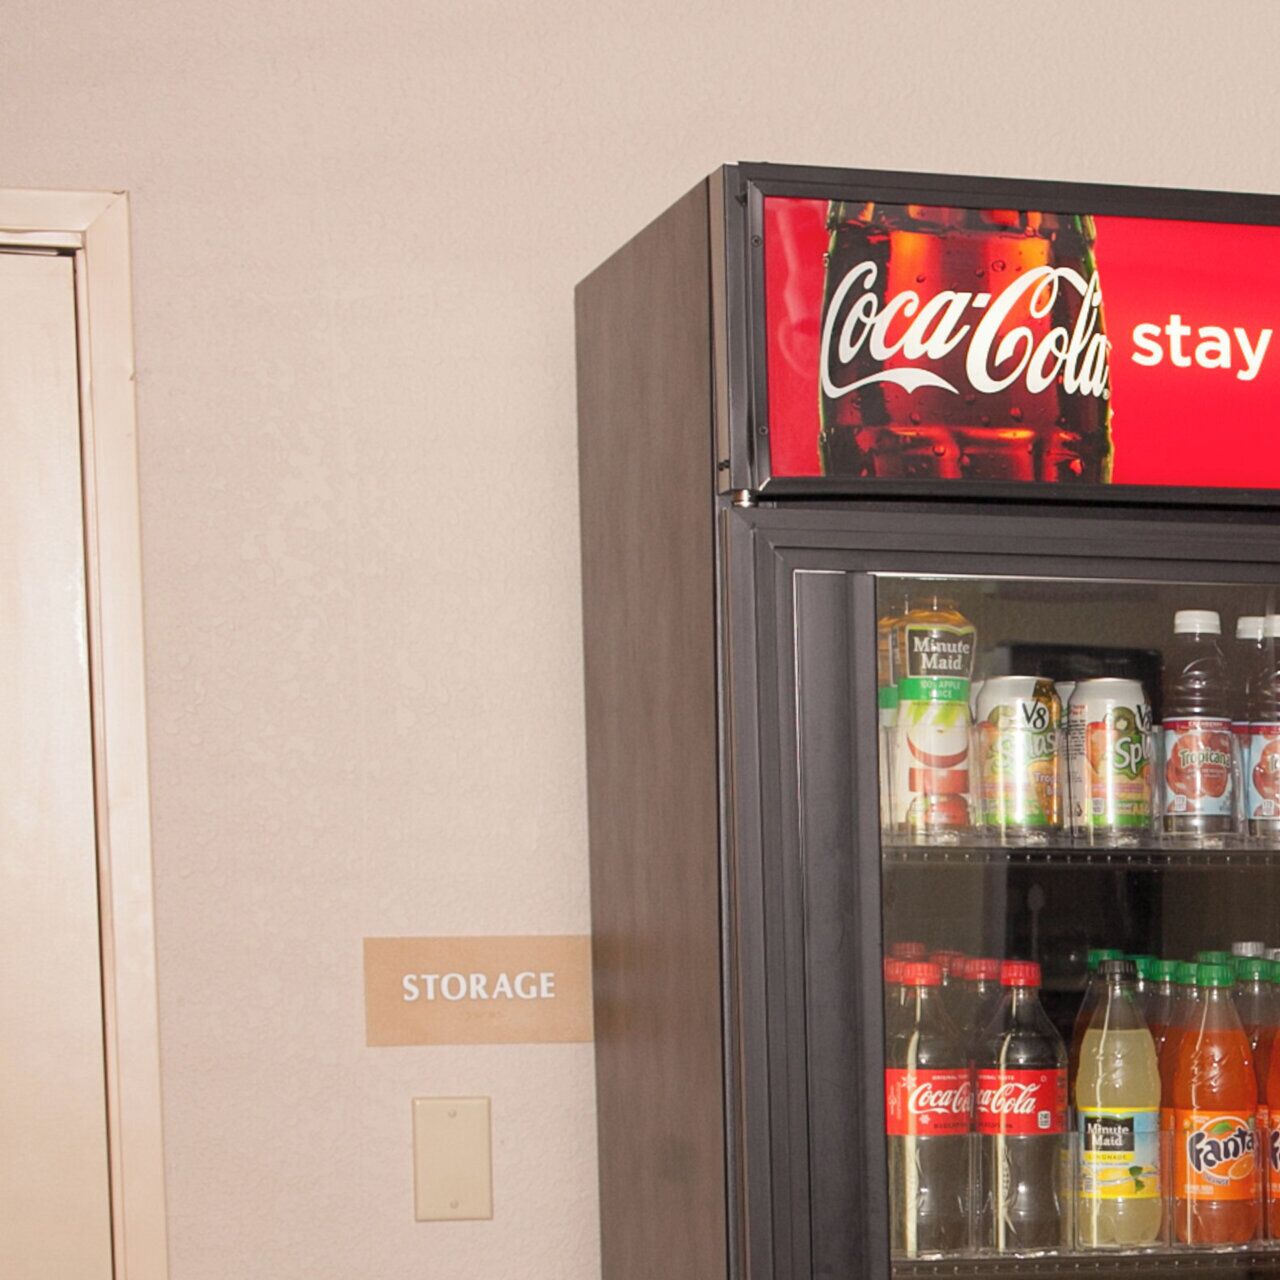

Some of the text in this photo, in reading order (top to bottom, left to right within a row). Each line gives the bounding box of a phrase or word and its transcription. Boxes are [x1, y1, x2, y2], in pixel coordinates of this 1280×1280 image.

[821, 261, 1112, 399] Coca-Cola
[1131, 314, 1273, 383] stay
[913, 636, 970, 654] Minute
[921, 653, 962, 670] Maid
[1022, 702, 1047, 729] V8
[403, 972, 555, 1001] STORAGE
[1087, 1123, 1129, 1135] Minute
[1091, 1134, 1123, 1146] Maid
